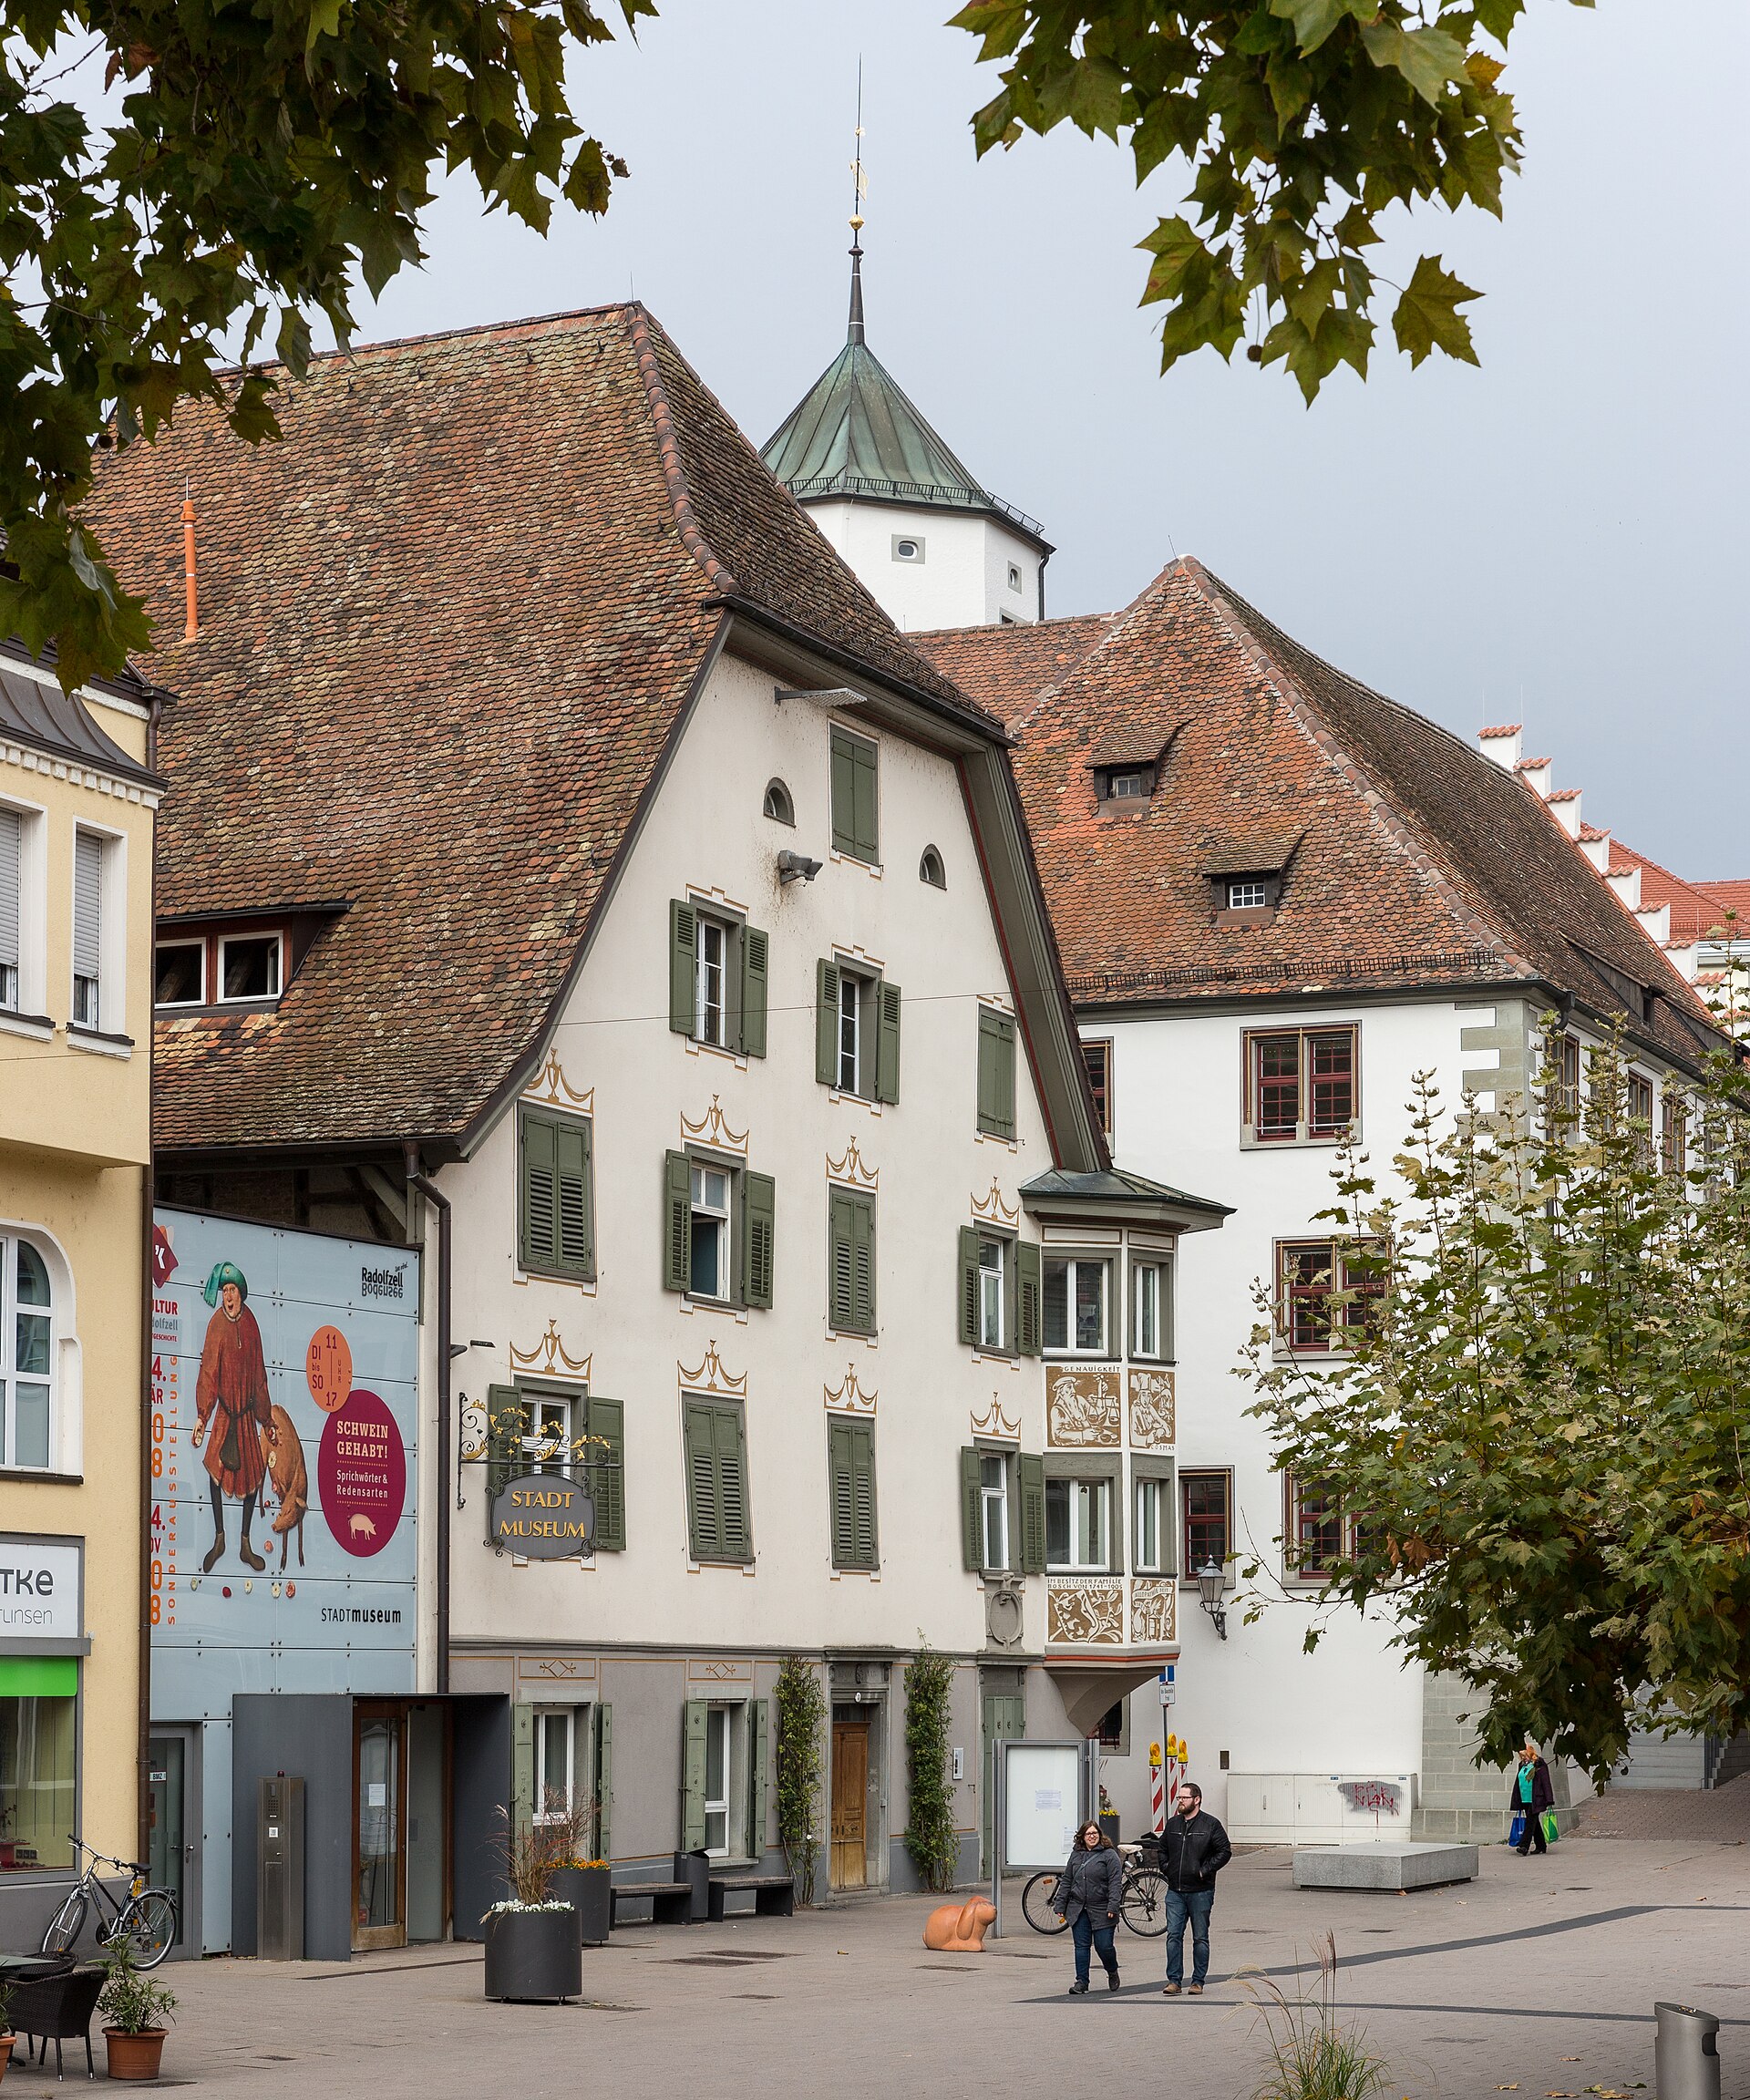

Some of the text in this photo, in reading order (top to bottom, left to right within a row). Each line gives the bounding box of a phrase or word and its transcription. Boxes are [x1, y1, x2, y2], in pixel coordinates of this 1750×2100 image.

[361, 1267, 404, 1288] Radolfzell
[325, 1333, 337, 1350] 11
[312, 1344, 322, 1361] DI
[312, 1362, 321, 1372] bis
[312, 1374, 324, 1390] SO
[325, 1391, 337, 1407] 17
[336, 1420, 388, 1439] SCHWEIN
[336, 1440, 388, 1459] GEHABT!
[336, 1469, 388, 1485] Sprichwörter &
[336, 1484, 388, 1499] Redensarten
[511, 1490, 575, 1509] STADT
[499, 1519, 586, 1539] MUSEUM
[321, 1607, 402, 1623] STADTmuseum
